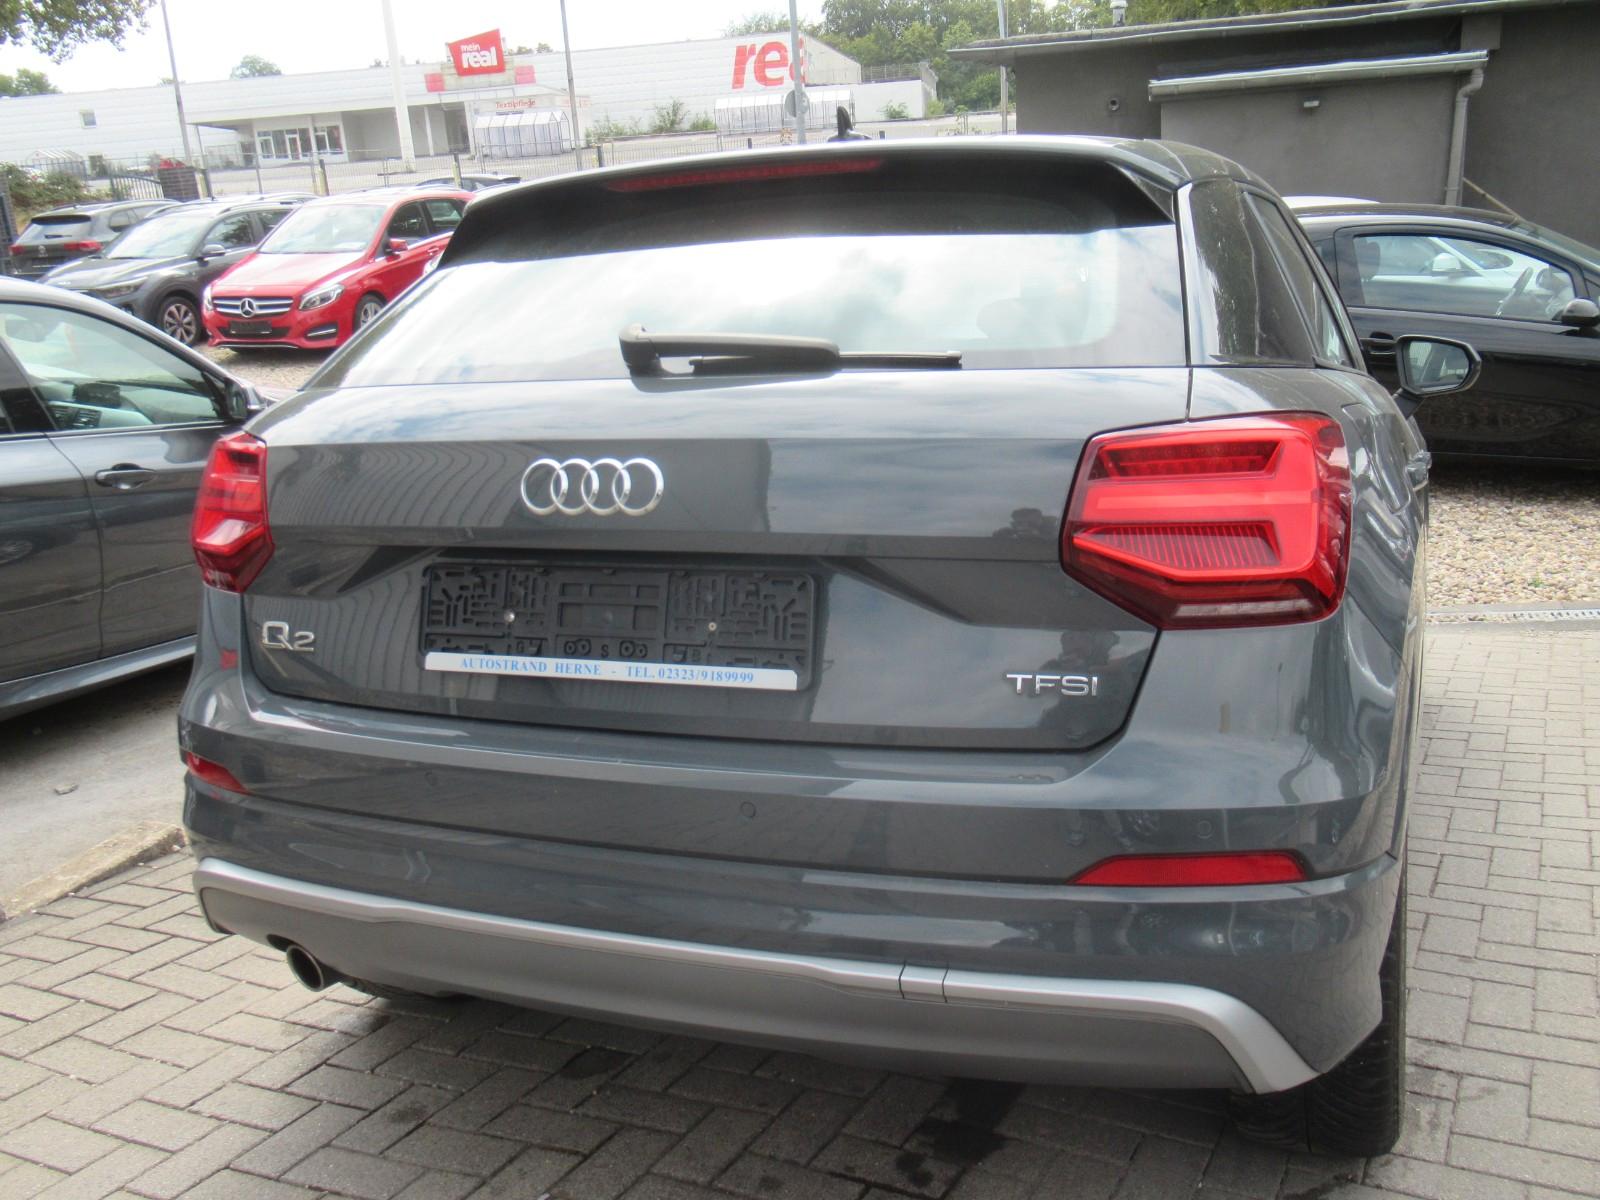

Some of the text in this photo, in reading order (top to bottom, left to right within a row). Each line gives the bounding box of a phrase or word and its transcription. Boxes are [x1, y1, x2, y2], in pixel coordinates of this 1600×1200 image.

[460, 43, 480, 52] mein
[462, 46, 498, 69] real
[262, 621, 315, 652] Q2
[461, 656, 548, 674] AUTOSTRAND
[554, 662, 601, 676] HERNE
[627, 665, 656, 680] TEL.
[657, 667, 754, 684] 02323/9189999
[1006, 673, 1098, 697] TFSI
